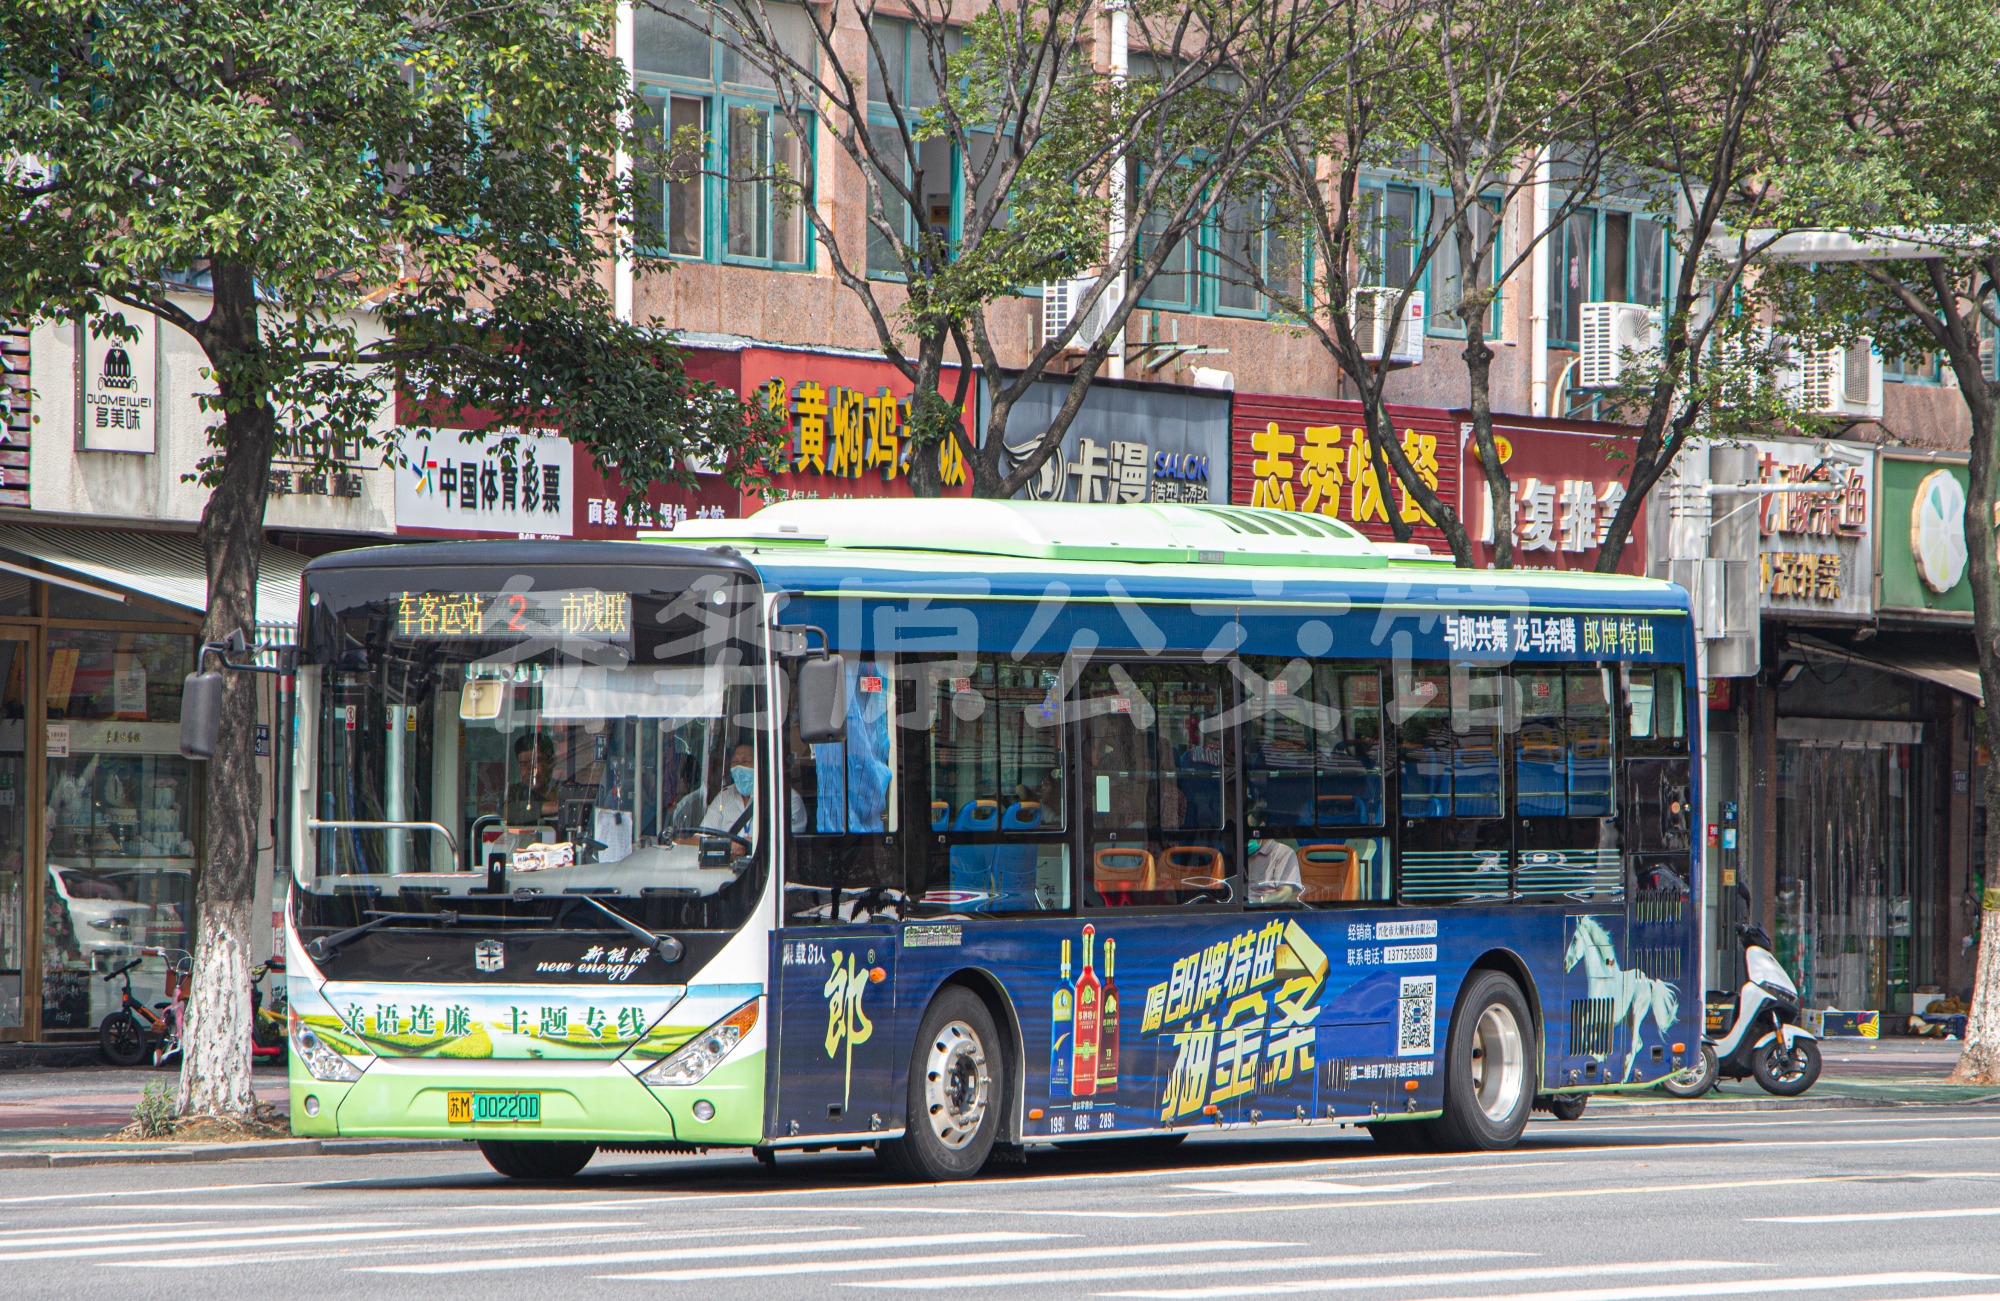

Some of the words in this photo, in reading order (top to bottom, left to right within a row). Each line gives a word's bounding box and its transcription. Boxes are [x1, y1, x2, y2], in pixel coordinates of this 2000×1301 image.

[87, 393, 151, 408] DUOMEIWEI
[96, 406, 140, 430] 多美味
[1068, 437, 1149, 503] 卡漫
[1154, 451, 1209, 481] SALON
[439, 458, 560, 513] 中国体育彩票
[588, 498, 618, 523] 面条
[398, 591, 483, 634] 车客运站
[508, 595, 526, 631] 2
[560, 591, 628, 634] 市残联
[1443, 615, 1508, 652] 与郎共舞
[1513, 616, 1576, 653] 龙马奔腾
[1583, 617, 1654, 655] 郎牌特曲
[580, 945, 651, 964] 新能源
[1388, 947, 1433, 961] 13775658888
[536, 961, 575, 973] new
[577, 962, 639, 981] energy
[1141, 918, 1284, 1034] 喝郎牌特曲
[501, 1005, 648, 1041] 主题专线
